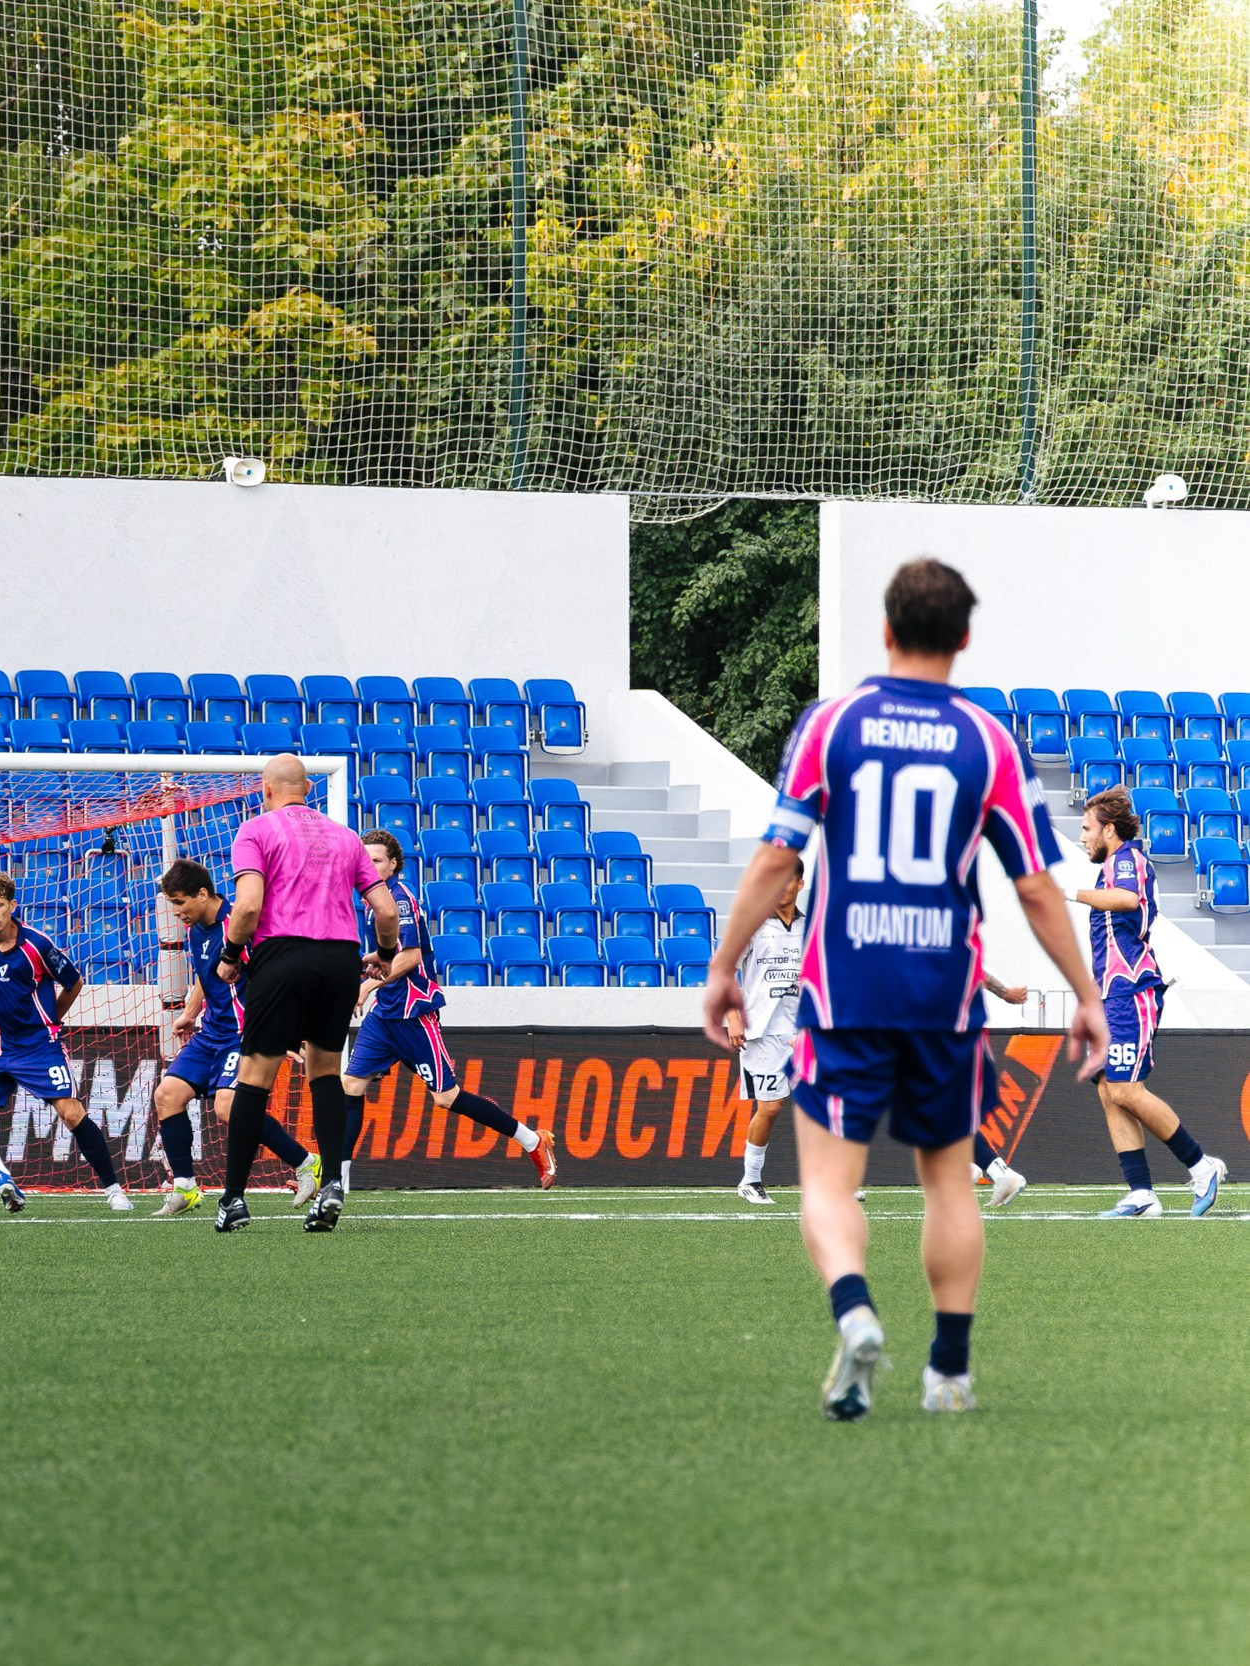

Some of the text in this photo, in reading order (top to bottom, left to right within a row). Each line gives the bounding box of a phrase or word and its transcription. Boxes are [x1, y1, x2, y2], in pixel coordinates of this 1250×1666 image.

[847, 760, 958, 885] 10
[846, 902, 953, 950] QUANTUM
[223, 1052, 240, 1072] 8
[1108, 1043, 1137, 1066] 96
[48, 1065, 71, 1086] 91
[756, 1074, 778, 1091] 72
